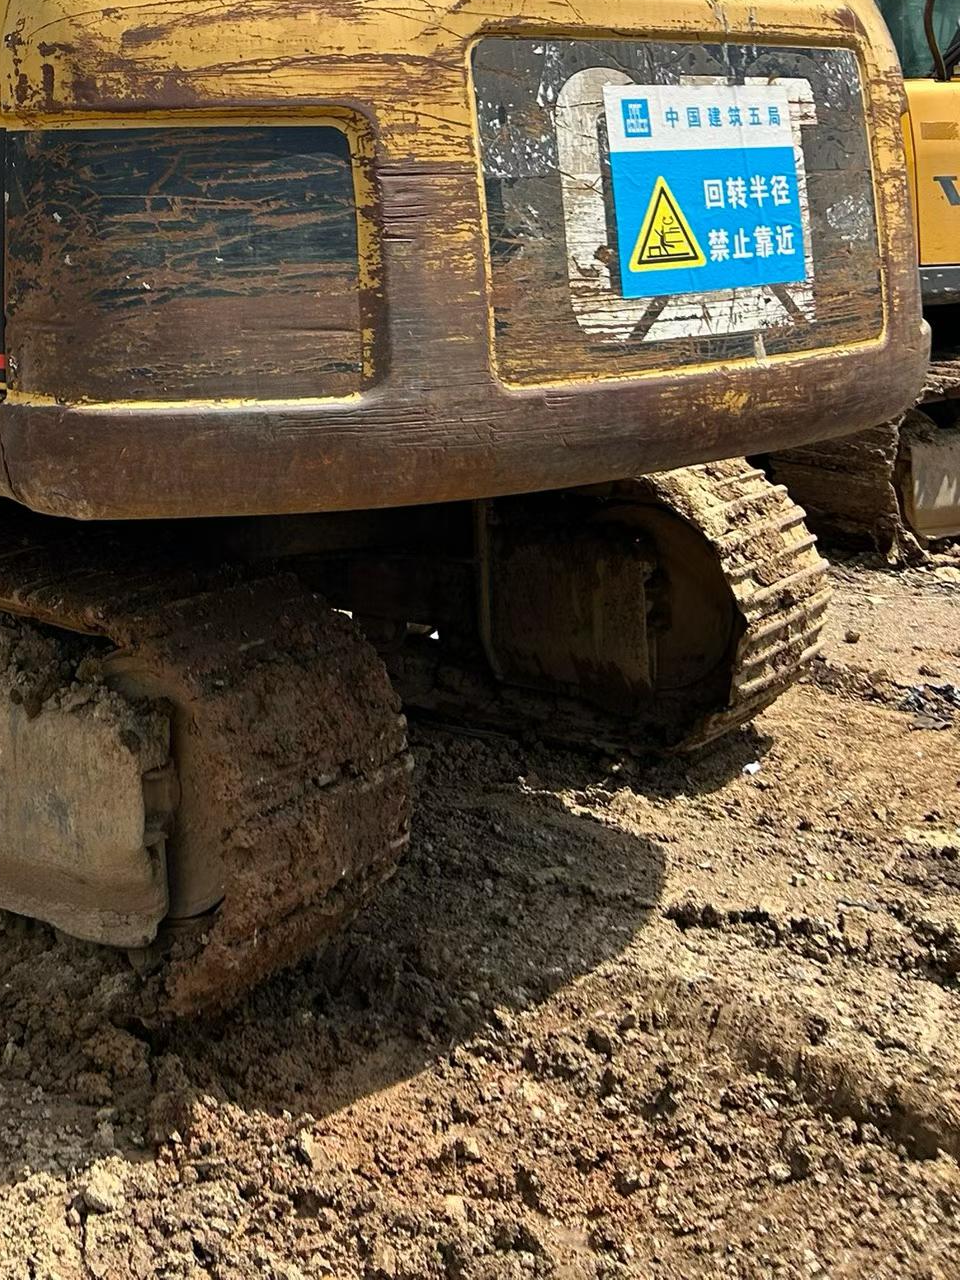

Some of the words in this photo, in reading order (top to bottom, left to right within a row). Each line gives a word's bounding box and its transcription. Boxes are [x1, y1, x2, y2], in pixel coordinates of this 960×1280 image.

[664, 105, 782, 129] 中国建筑五局
[703, 174, 792, 210] 回转半径
[707, 224, 796, 263] 禁止靠近
